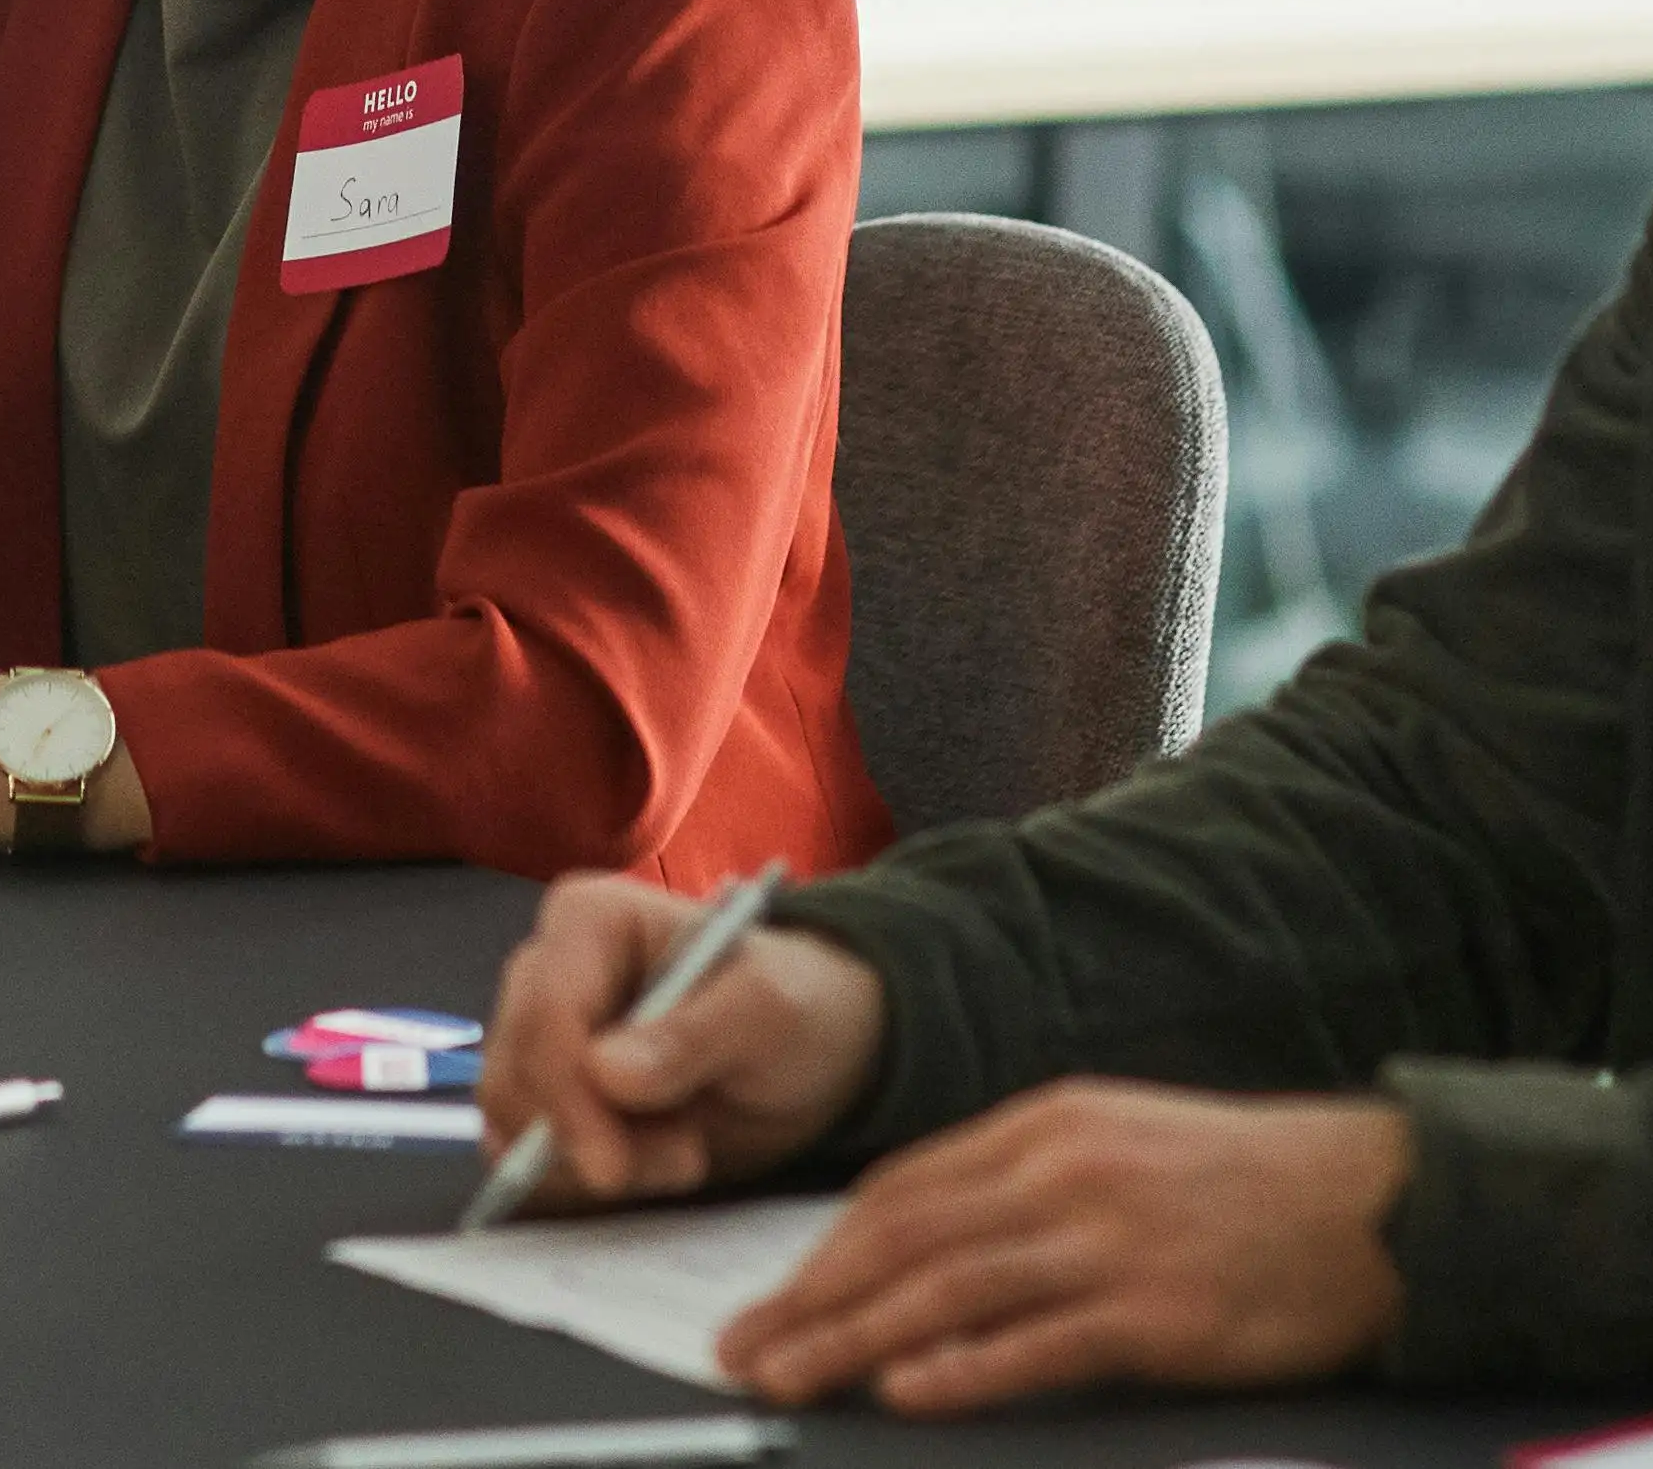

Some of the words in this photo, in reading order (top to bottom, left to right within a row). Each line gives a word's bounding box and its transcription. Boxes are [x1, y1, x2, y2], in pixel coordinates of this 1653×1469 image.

[363, 79, 418, 115] HELLO
[362, 119, 379, 134] my
[379, 111, 404, 127] name
[405, 106, 414, 121] is
[330, 176, 399, 221] Sara
